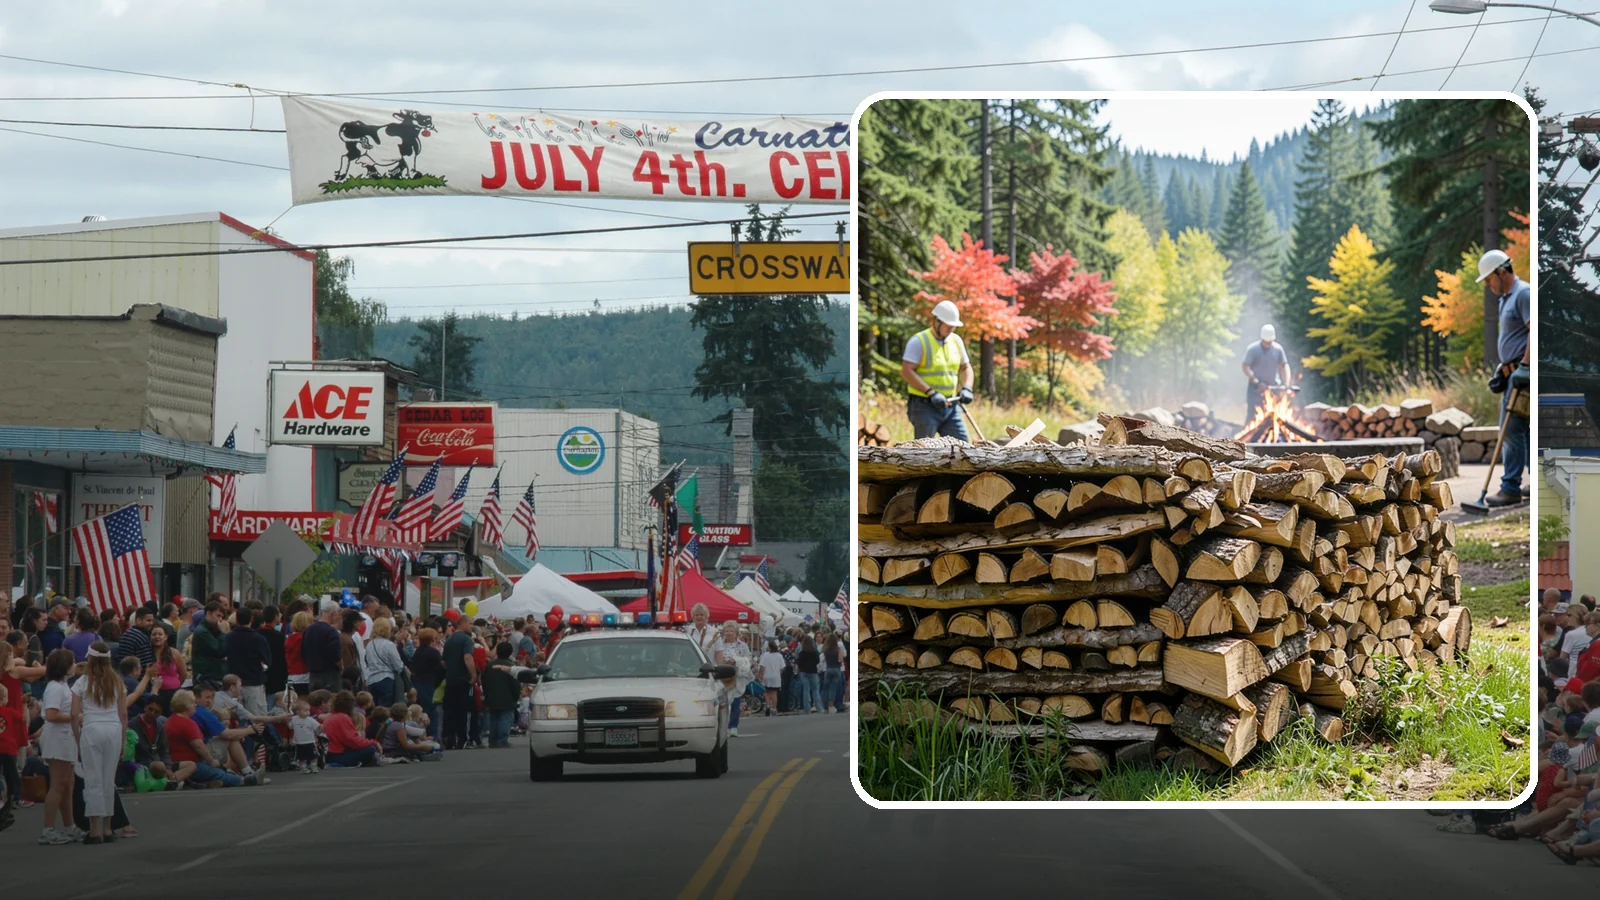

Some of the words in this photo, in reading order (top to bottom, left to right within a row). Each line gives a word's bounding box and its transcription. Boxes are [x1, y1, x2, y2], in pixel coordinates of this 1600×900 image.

[481, 140, 605, 192] JULY
[632, 150, 746, 198] 4th.
[697, 254, 850, 280] CROSSWA
[282, 380, 373, 420] ACE
[405, 409, 453, 422] CEDAR
[283, 421, 371, 436] Hardware
[416, 428, 477, 447] Coca-Cola
[353, 467, 385, 480] Simpl
[83, 485, 94, 494] St.
[95, 485, 124, 495] Vincent
[126, 486, 136, 495] de
[138, 486, 155, 495] Paul
[688, 526, 741, 535] CRNATION
[699, 535, 730, 543] GLASS
